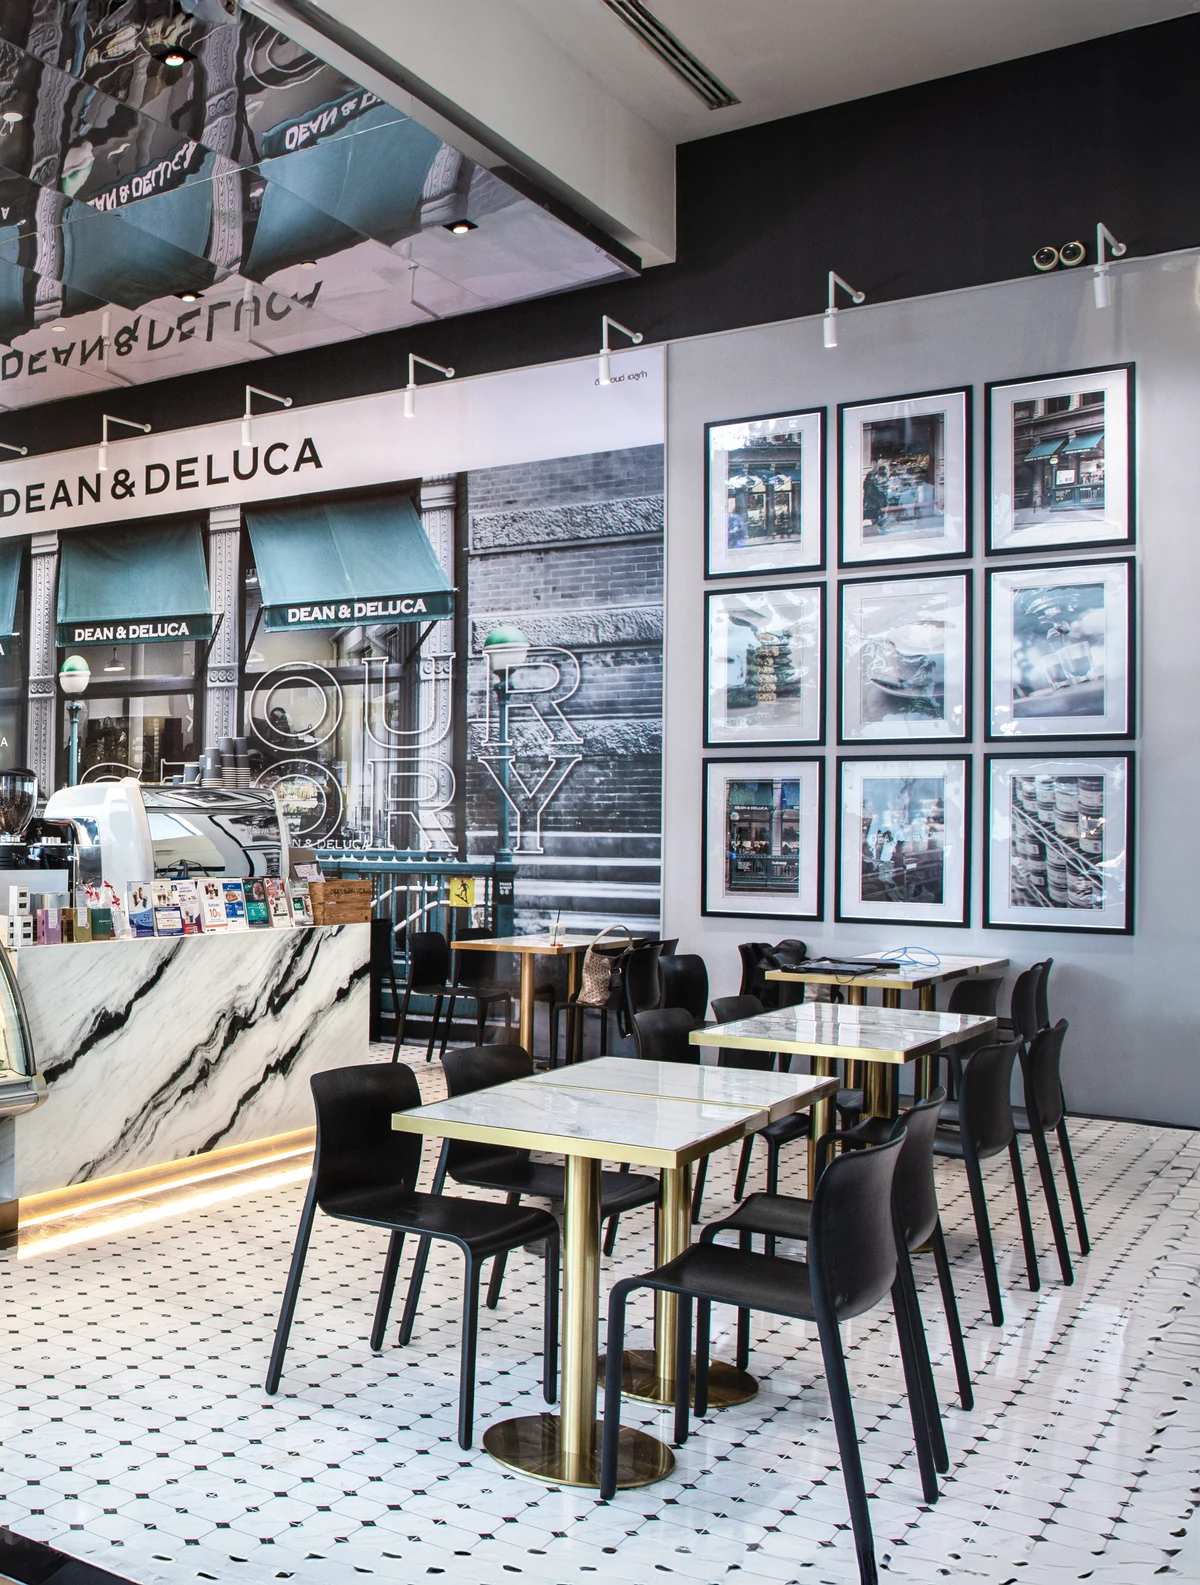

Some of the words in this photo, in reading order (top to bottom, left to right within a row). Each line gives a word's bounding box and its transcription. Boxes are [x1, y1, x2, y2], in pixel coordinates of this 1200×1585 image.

[0, 473, 101, 518] DEAN
[110, 468, 135, 499] &
[145, 437, 323, 496] DELUCA
[288, 604, 336, 623] DEAN
[338, 604, 351, 619] &
[354, 598, 427, 617] DELUCA
[74, 625, 114, 642] DEAN
[116, 625, 127, 640] &
[132, 622, 190, 639] DELUCA
